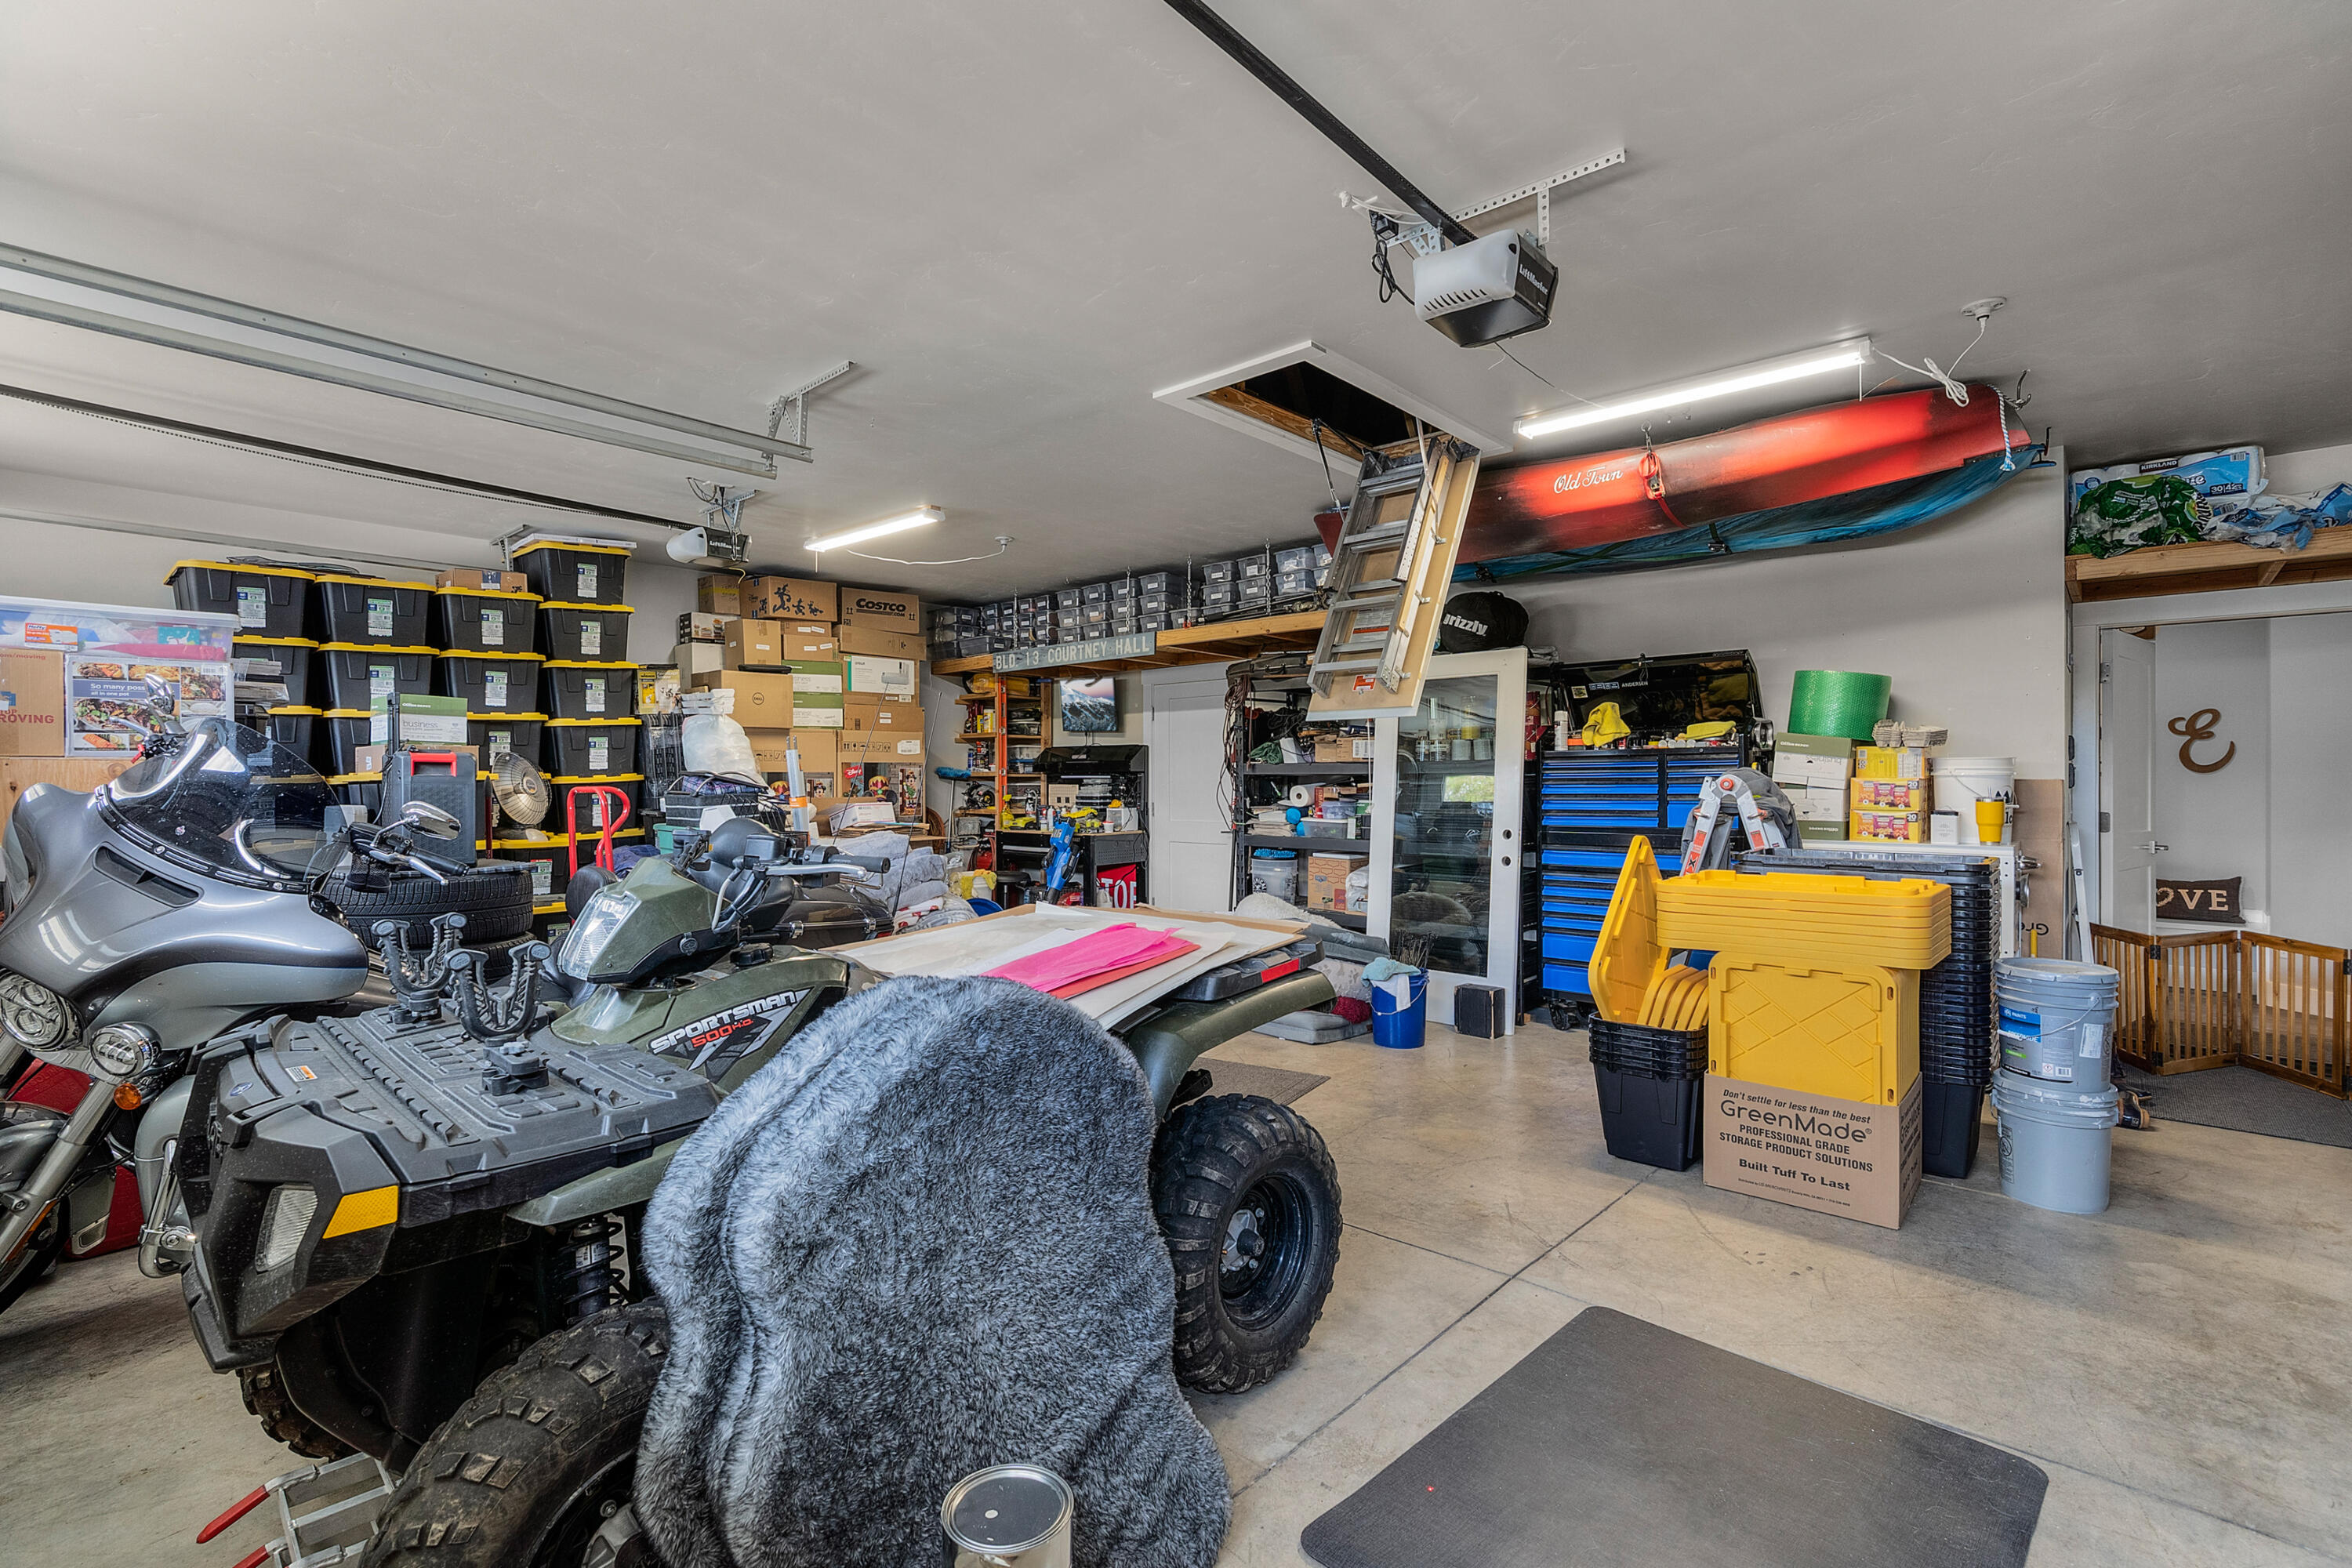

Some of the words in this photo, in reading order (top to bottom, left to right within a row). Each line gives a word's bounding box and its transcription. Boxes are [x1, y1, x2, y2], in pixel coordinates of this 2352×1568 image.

[1519, 263, 1548, 296] LiftMaster
[1554, 472, 1581, 494] Old
[1582, 466, 1624, 487] Town
[2140, 460, 2178, 470] KIRKLAND
[856, 598, 906, 612] COSTCO
[1443, 614, 1489, 635] grizzly
[1025, 651, 1040, 666] 13
[1047, 641, 1107, 663] COURTNEY
[1116, 636, 1150, 655] HALL
[2168, 708, 2236, 774] E
[650, 991, 796, 1054] SPORTSMAN
[691, 1024, 733, 1048] 500
[1723, 1089, 1745, 1101] Don't
[1747, 1093, 1772, 1105] settle
[1774, 1099, 1787, 1108] for
[1789, 1102, 1807, 1112] less
[1809, 1105, 1830, 1116] than
[1832, 1110, 1847, 1120] the
[1849, 1113, 1871, 1124] best
[1719, 1131, 1763, 1149] STORAGE
[1766, 1142, 1813, 1160] PRODUCT
[1815, 1152, 1874, 1173] SOLUTIONS
[1739, 1123, 1813, 1147] PROFESSIONAL
[1815, 1139, 1851, 1155] GRADE
[1738, 1158, 1769, 1173] Built
[1772, 1165, 1798, 1179] Tuff
[1801, 1172, 1817, 1184] To
[1820, 1176, 1851, 1192] Last
